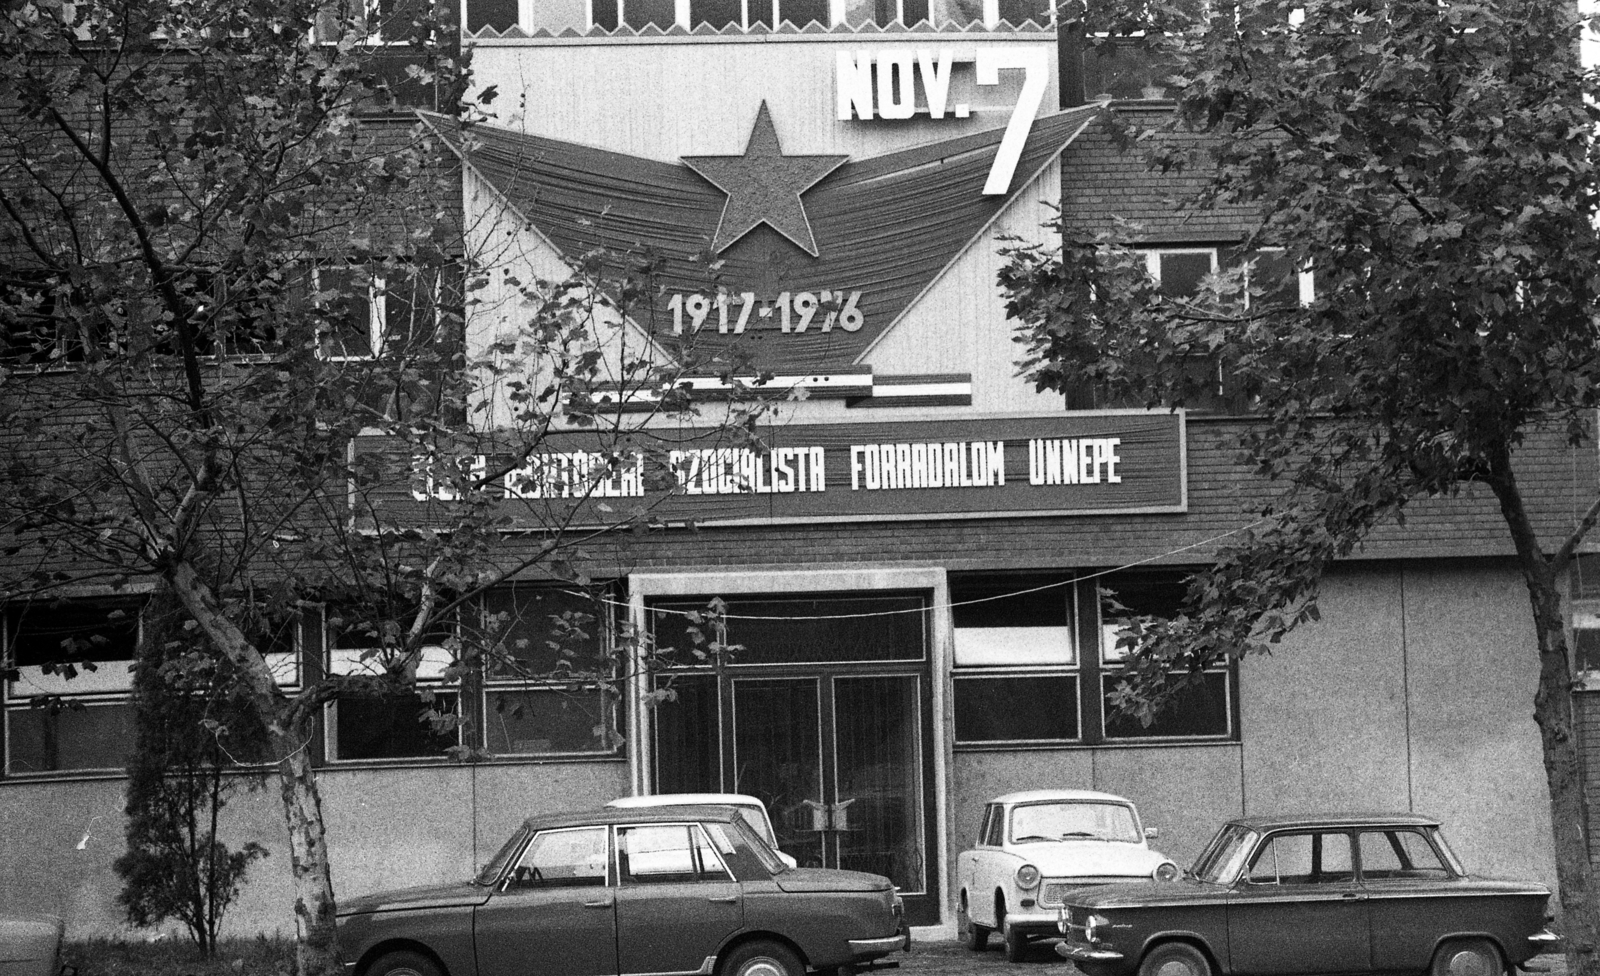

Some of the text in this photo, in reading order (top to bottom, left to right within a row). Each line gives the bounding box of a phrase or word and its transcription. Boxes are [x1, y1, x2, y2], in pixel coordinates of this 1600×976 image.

[836, 46, 1049, 196] NOV. 7
[667, 290, 865, 335] 1917-1976
[669, 446, 826, 495] SZOCIALISTA
[850, 441, 1005, 491] FORRADALOM
